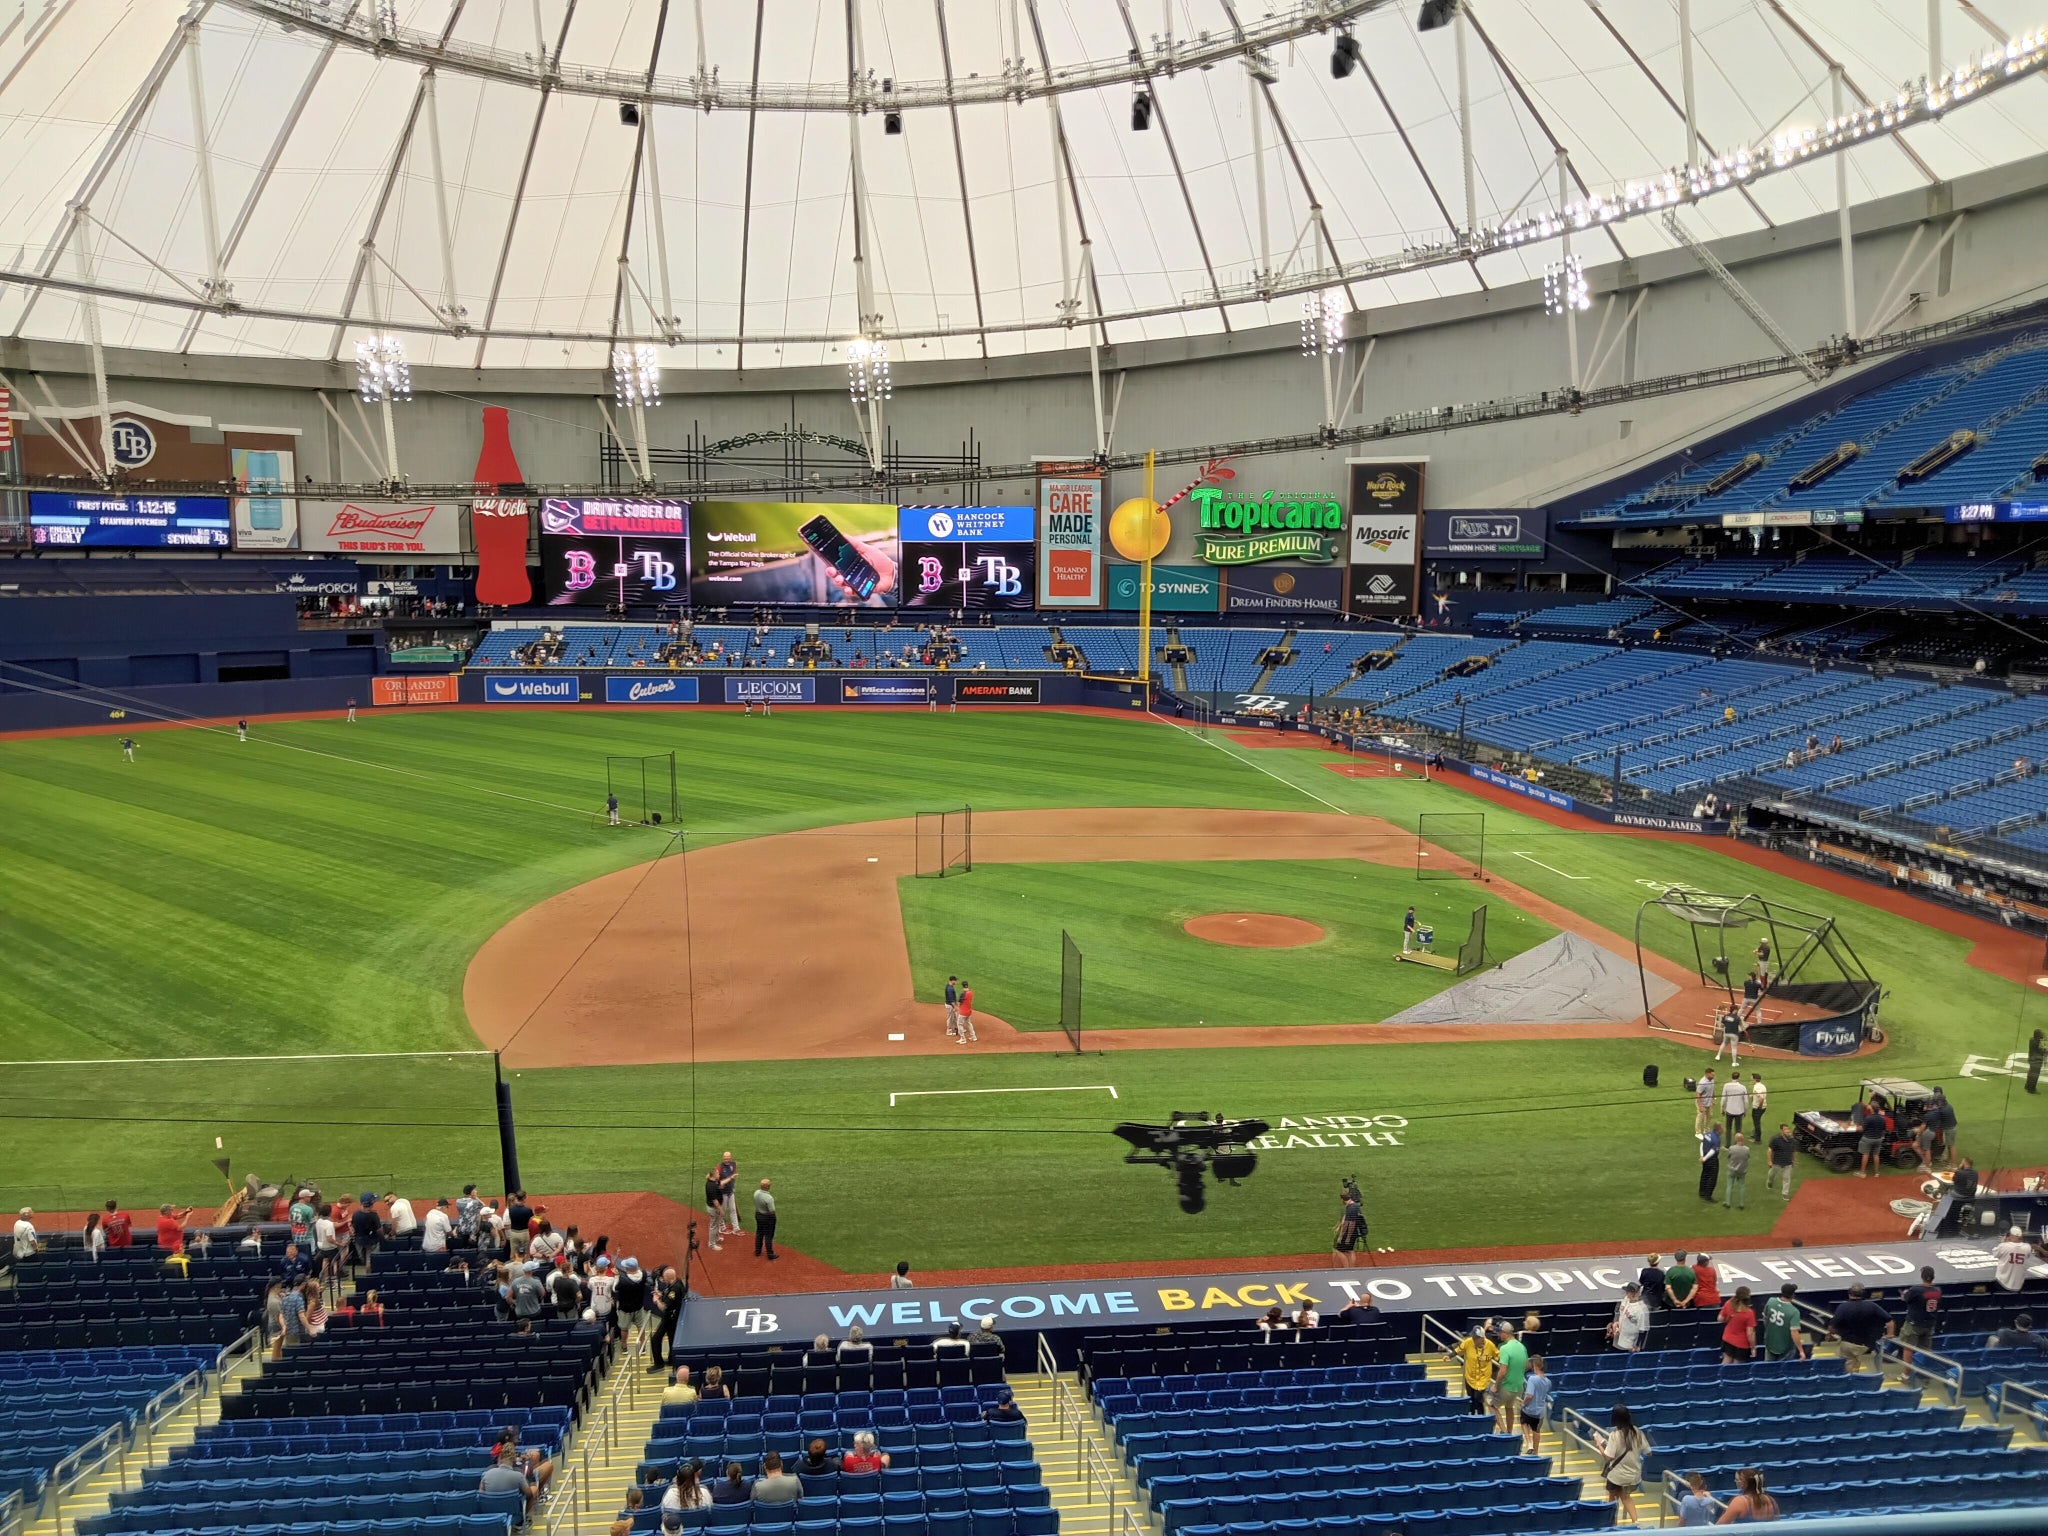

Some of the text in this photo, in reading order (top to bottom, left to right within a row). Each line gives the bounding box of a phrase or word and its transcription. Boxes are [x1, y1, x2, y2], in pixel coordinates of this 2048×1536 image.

[1367, 480, 1406, 491] Hard Rock
[77, 501, 177, 514] FIRST PITCH: 1:12:15
[583, 501, 682, 518] DRIVE SOBER OR
[1050, 493, 1092, 513] CARE
[1191, 488, 1341, 534] Tropicana
[337, 511, 424, 530] Budweiser
[583, 516, 683, 532] GET PULLED OVER
[957, 520, 1005, 528] WHITNEY
[1049, 515, 1092, 533] MADE
[723, 533, 757, 542] Webull
[1049, 534, 1092, 544] PERSONAL
[1356, 526, 1410, 540] Mosaic
[338, 541, 426, 551] THIS BUD'S FOR YOU.
[1205, 537, 1321, 560] PURE PREMIUM
[1449, 544, 1473, 552] UNION
[1474, 544, 1497, 552] HOME
[1498, 544, 1541, 552] MORTGAGE
[1053, 566, 1088, 574] ORLANDO
[1057, 573, 1084, 581] HEALTH
[318, 583, 357, 593] PORCH
[1158, 583, 1209, 594] SYNNEX
[1230, 597, 1338, 608] DREAM FINDERS HOMES
[384, 679, 445, 691] ORLANDO
[520, 682, 569, 696] Webull
[629, 679, 676, 700] Culver's
[962, 686, 1032, 695] AMERANT BANK
[392, 691, 440, 702] HEALTH
[1614, 814, 1702, 832] RAYMOND JAMES
[2008, 1252, 2026, 1265] 15
[596, 1287, 604, 1296] 11
[828, 1291, 1140, 1327] WELCOME
[1157, 1283, 1321, 1312] BACK
[1329, 1278, 1412, 1303] TO
[1423, 1262, 1762, 1298] TROPICA
[1762, 1248, 1916, 1284] FIELD
[725, 1307, 779, 1334] TB
[1769, 1308, 1785, 1327] 35
